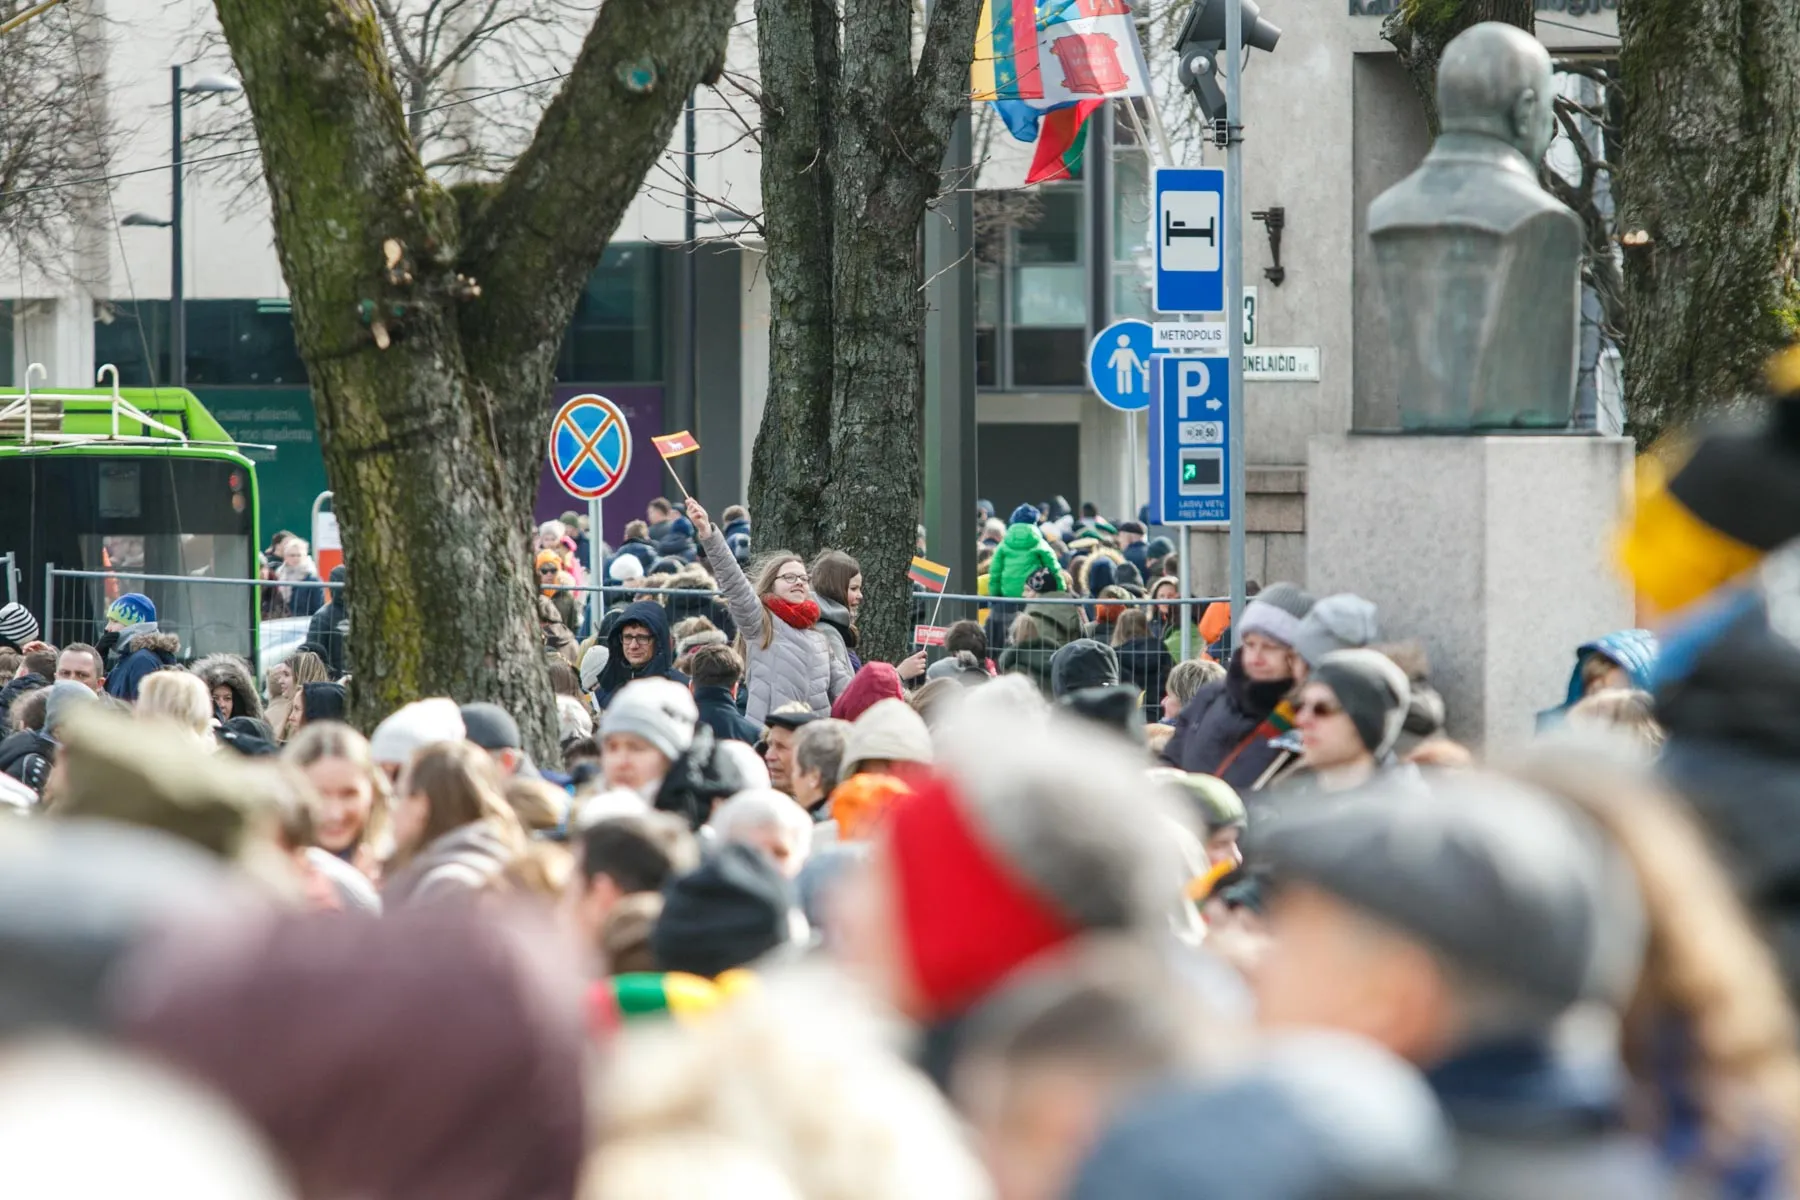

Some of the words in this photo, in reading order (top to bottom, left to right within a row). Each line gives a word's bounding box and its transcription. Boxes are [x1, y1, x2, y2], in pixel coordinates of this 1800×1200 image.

[1160, 330, 1222, 341] METROPOLIS
[1178, 361, 1210, 419] P
[1205, 427, 1215, 438] 50
[1179, 510, 1196, 518] FREE
[1199, 510, 1224, 518] SPACES
